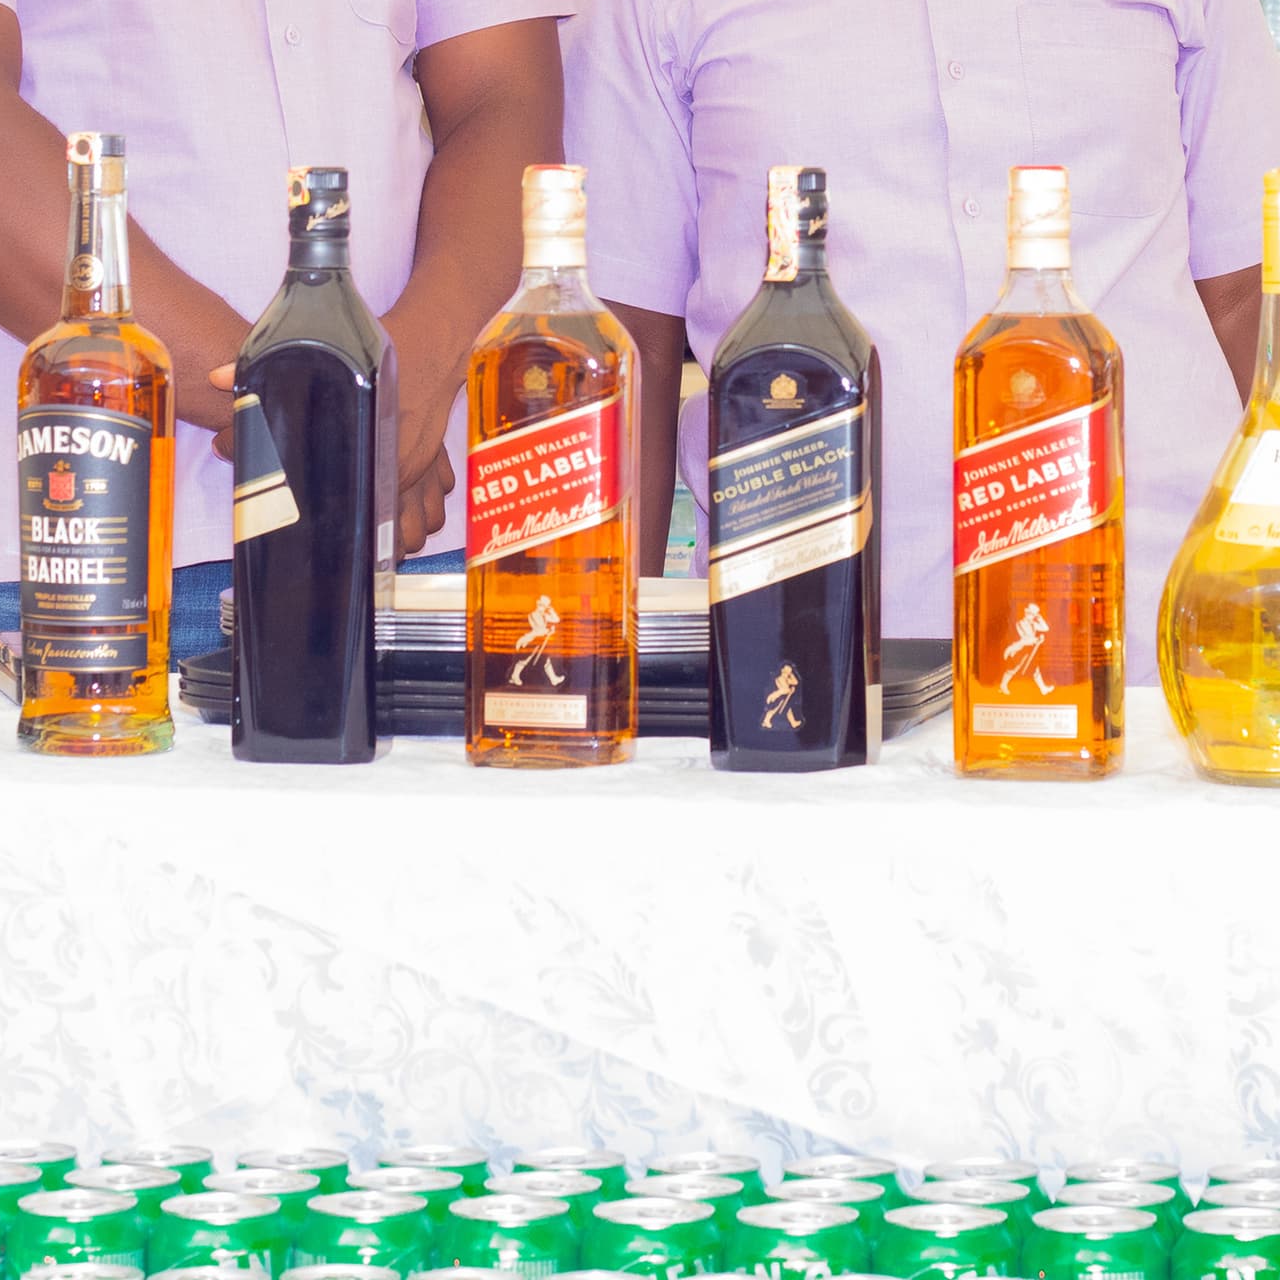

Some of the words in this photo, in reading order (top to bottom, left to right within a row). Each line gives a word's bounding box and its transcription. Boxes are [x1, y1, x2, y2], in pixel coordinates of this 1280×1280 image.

[18, 425, 135, 465] JAMESON
[477, 449, 534, 481] JOHNNIE
[534, 431, 588, 457] WALKER
[733, 457, 782, 482] JOHNNIE
[781, 440, 827, 462] WALKER
[963, 455, 1021, 486] JOHNNIE
[1021, 436, 1079, 462] WALKER
[472, 474, 519, 506] RED
[523, 447, 602, 487] LABEL
[713, 469, 785, 504] DOUBLE
[789, 445, 850, 477] BLACK
[957, 480, 1005, 512] RED
[1010, 451, 1091, 493] LABEL
[472, 502, 515, 522] BLENDED
[520, 487, 558, 506] SCOTCH
[1006, 493, 1047, 512] SCOTCH
[31, 516, 101, 545] BLACK
[483, 521, 520, 555] John
[969, 529, 1008, 563] John
[27, 555, 111, 585] BARREL
